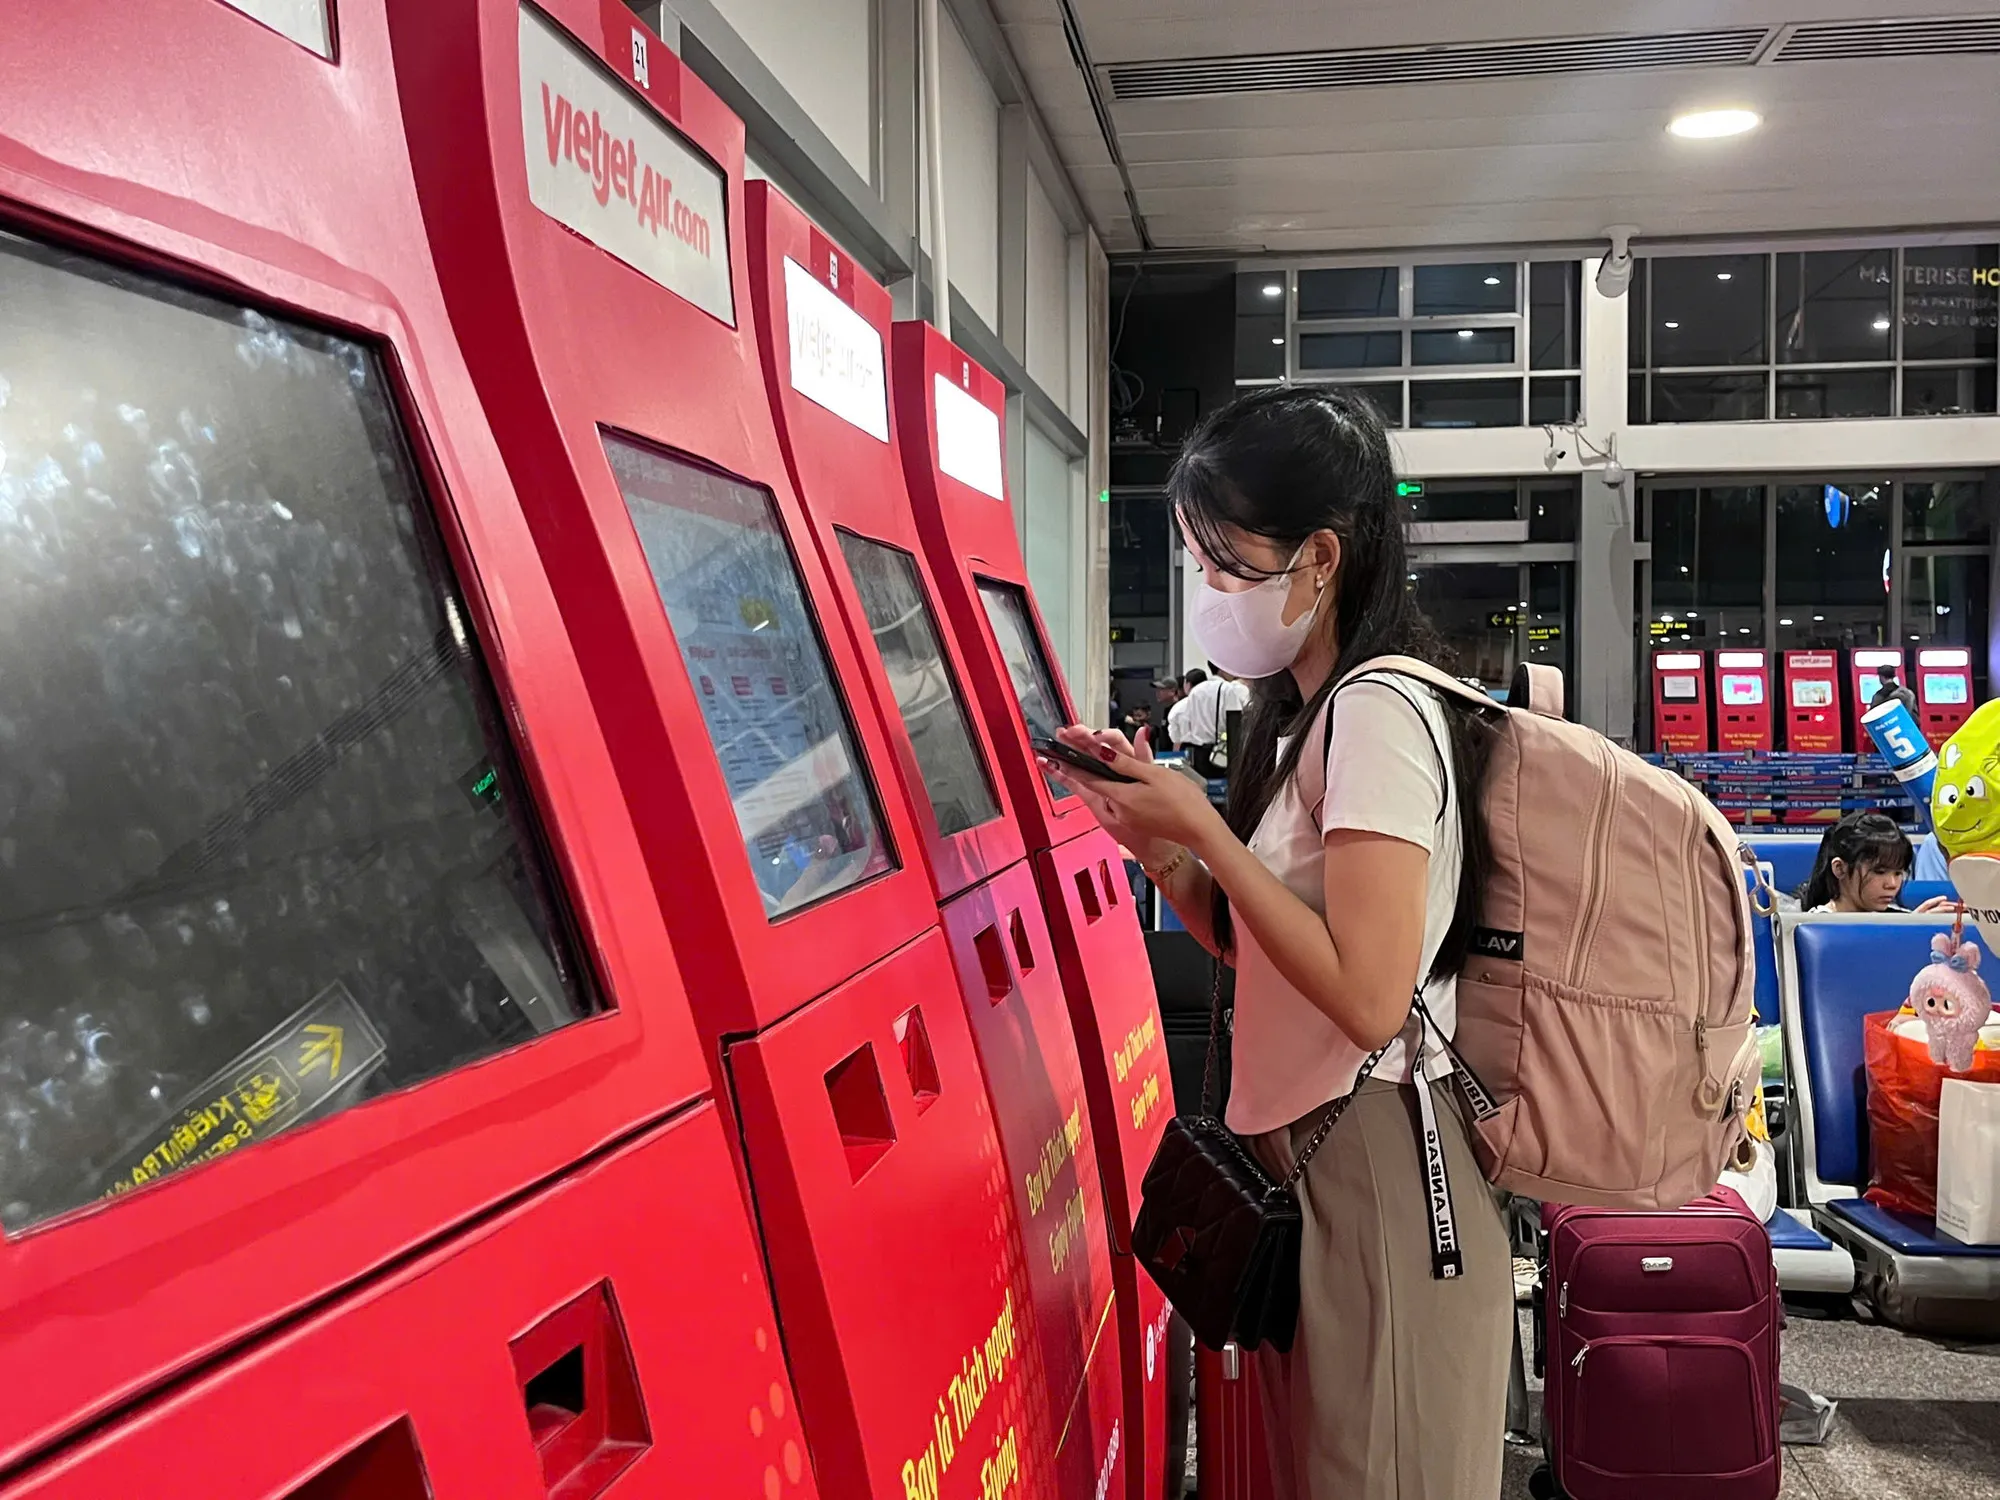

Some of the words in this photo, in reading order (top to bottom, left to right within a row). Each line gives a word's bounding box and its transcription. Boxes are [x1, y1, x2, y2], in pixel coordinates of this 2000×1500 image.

[634, 40, 645, 70] 21
[1884, 726, 1916, 759] 5
[1874, 799, 1897, 807] TIA
[1477, 935, 1517, 952] LAV
[1049, 1222, 1070, 1275] Enjoy
[1066, 1186, 1086, 1240] Flying
[902, 1440, 939, 1500] Bay
[934, 1395, 955, 1474] là
[948, 1345, 988, 1442] Thích
[984, 1287, 1016, 1383] ngay!
[981, 1426, 1019, 1500] Flying
